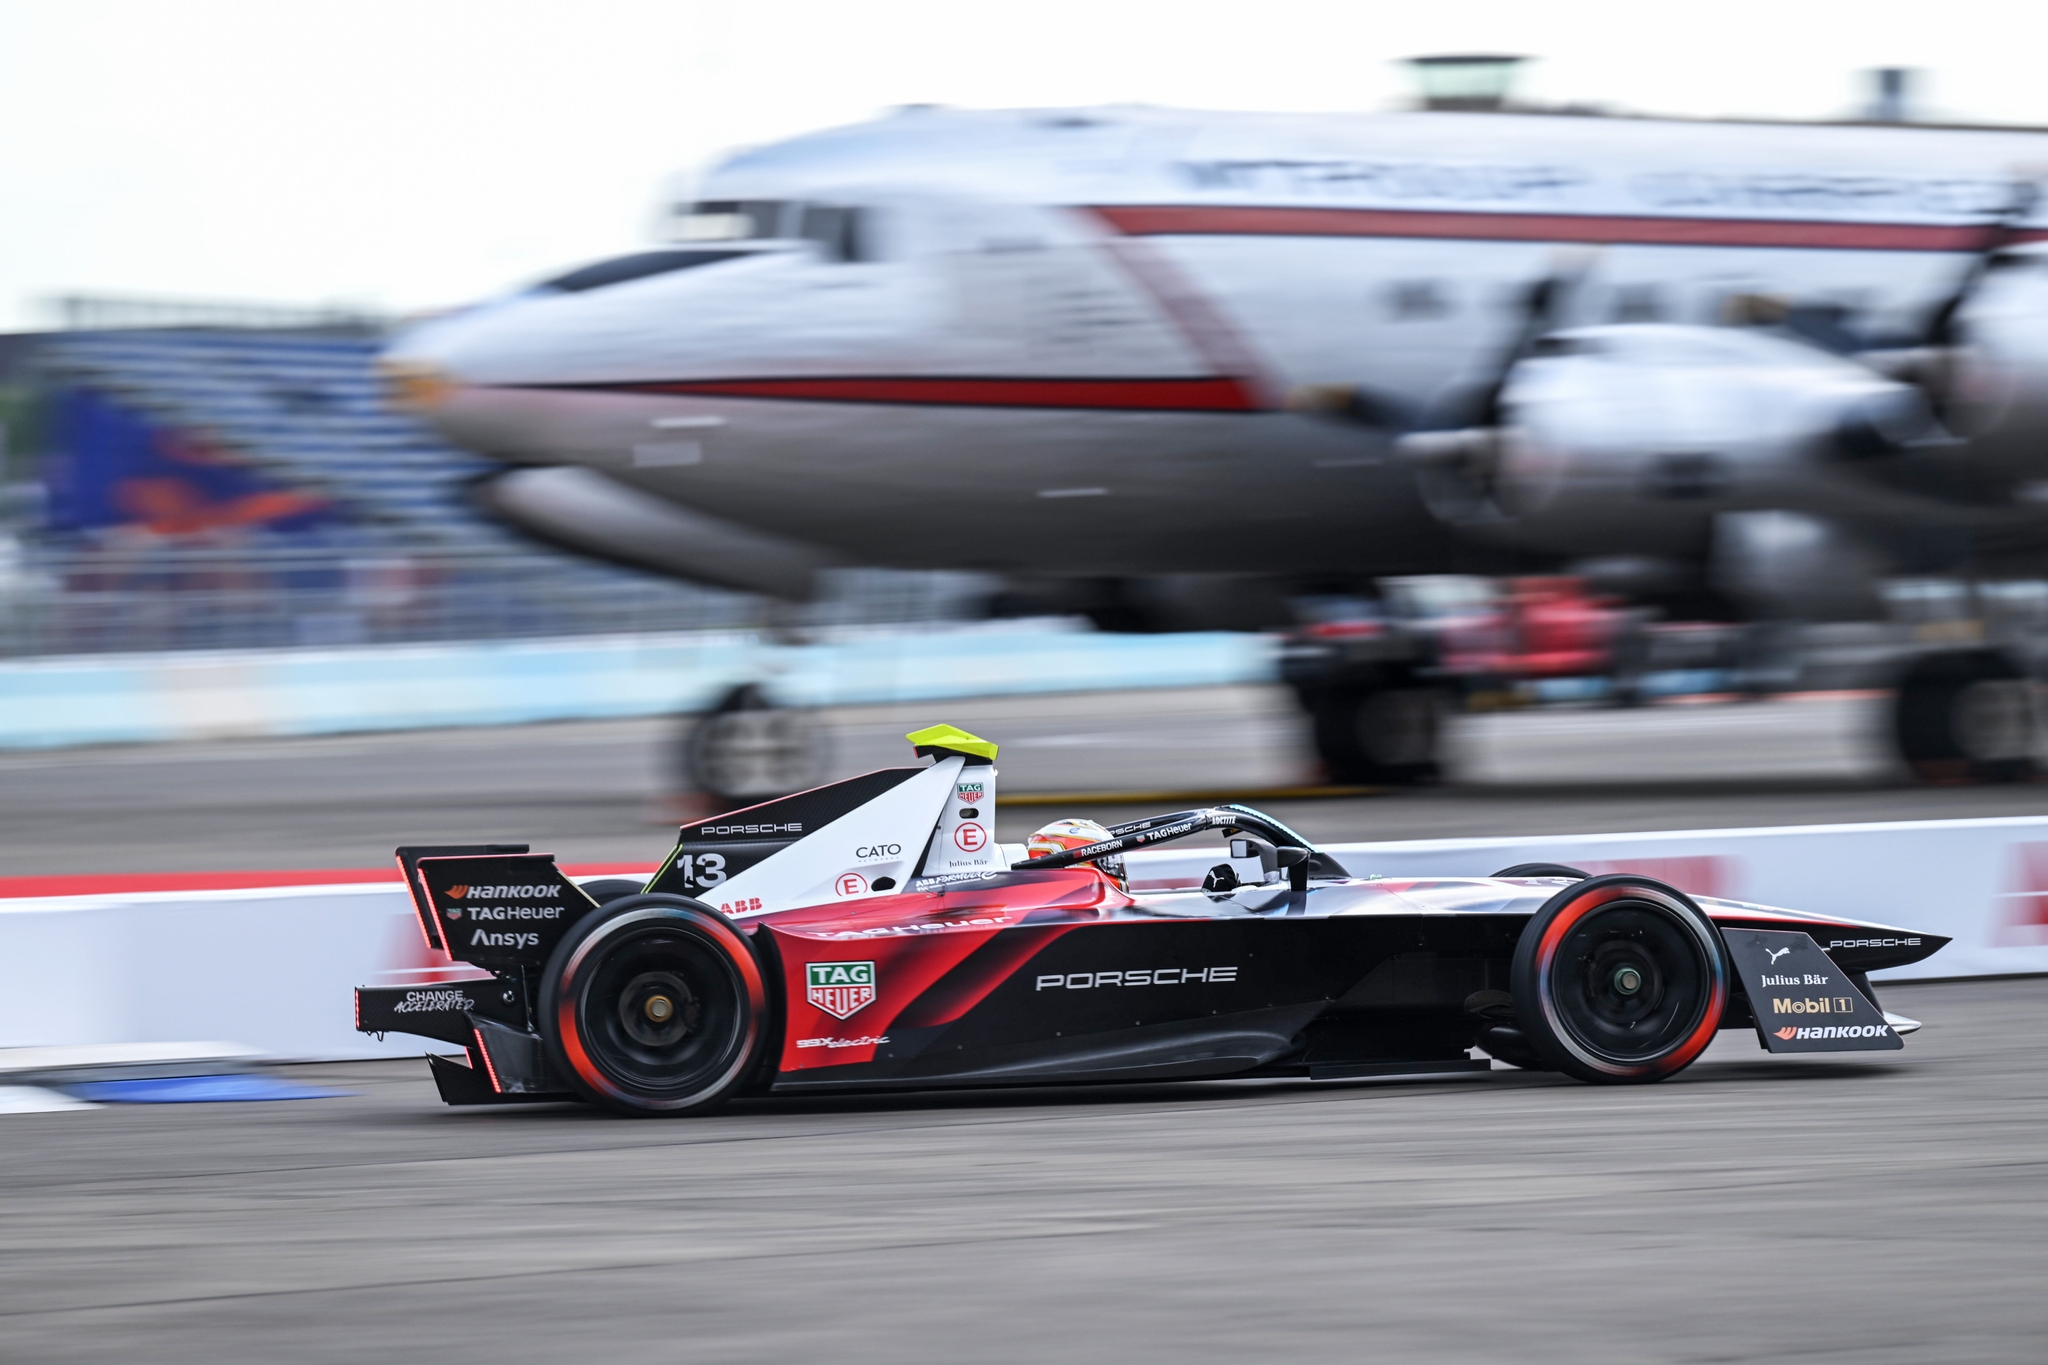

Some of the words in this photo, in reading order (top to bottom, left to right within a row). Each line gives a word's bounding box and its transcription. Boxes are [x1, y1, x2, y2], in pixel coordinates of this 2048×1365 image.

[959, 792, 982, 802] HEUER
[701, 822, 803, 836] PORSCHE
[856, 844, 902, 858] CATO
[1080, 839, 1123, 857] RACEBORN
[676, 852, 727, 889] 13
[949, 860, 972, 868] Julius
[915, 878, 935, 887] ABB
[720, 897, 762, 914] ABB
[470, 929, 539, 949] Ansys
[1830, 938, 1922, 949] PORSCHE
[812, 966, 868, 983] TAG
[1035, 966, 1239, 991] PORSCHE
[1761, 974, 1801, 987] Julius
[1803, 974, 1829, 985] Bär
[812, 987, 871, 1015] HEUER
[1772, 997, 1831, 1014] Mobil
